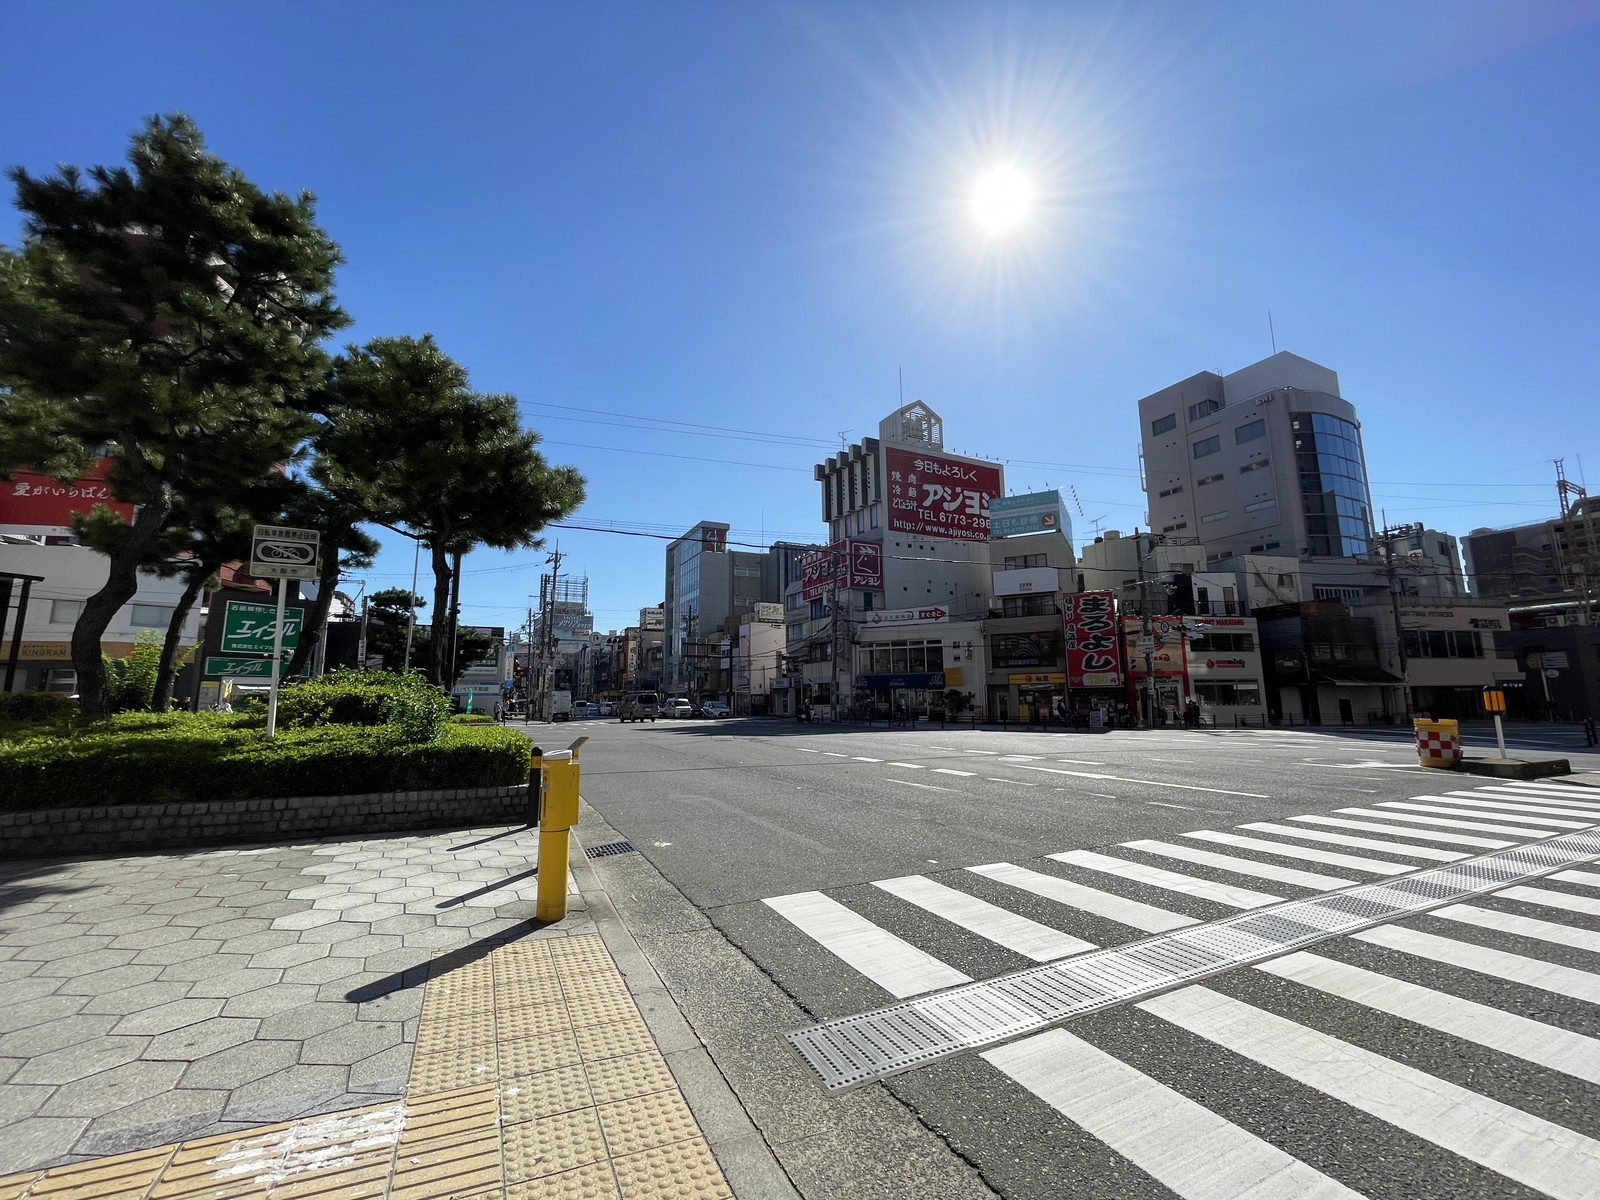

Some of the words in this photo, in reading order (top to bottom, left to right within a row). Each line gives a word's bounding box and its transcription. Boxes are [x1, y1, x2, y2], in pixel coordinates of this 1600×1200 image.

[891, 470, 917, 485] 焼肉
[913, 459, 978, 482] 今日もよろしく
[892, 498, 918, 512] どじょう汁
[922, 484, 990, 517] アジヨシ
[918, 508, 937, 521] TEL
[992, 515, 1039, 529] 土日も診療
[257, 528, 317, 540] 自転車放置禁止区域
[270, 567, 297, 575] 大阪市
[853, 576, 880, 586] アジヨシ
[227, 618, 301, 640] エイブル
[1077, 594, 1116, 671] まろよし
[218, 660, 266, 675] エイブル
